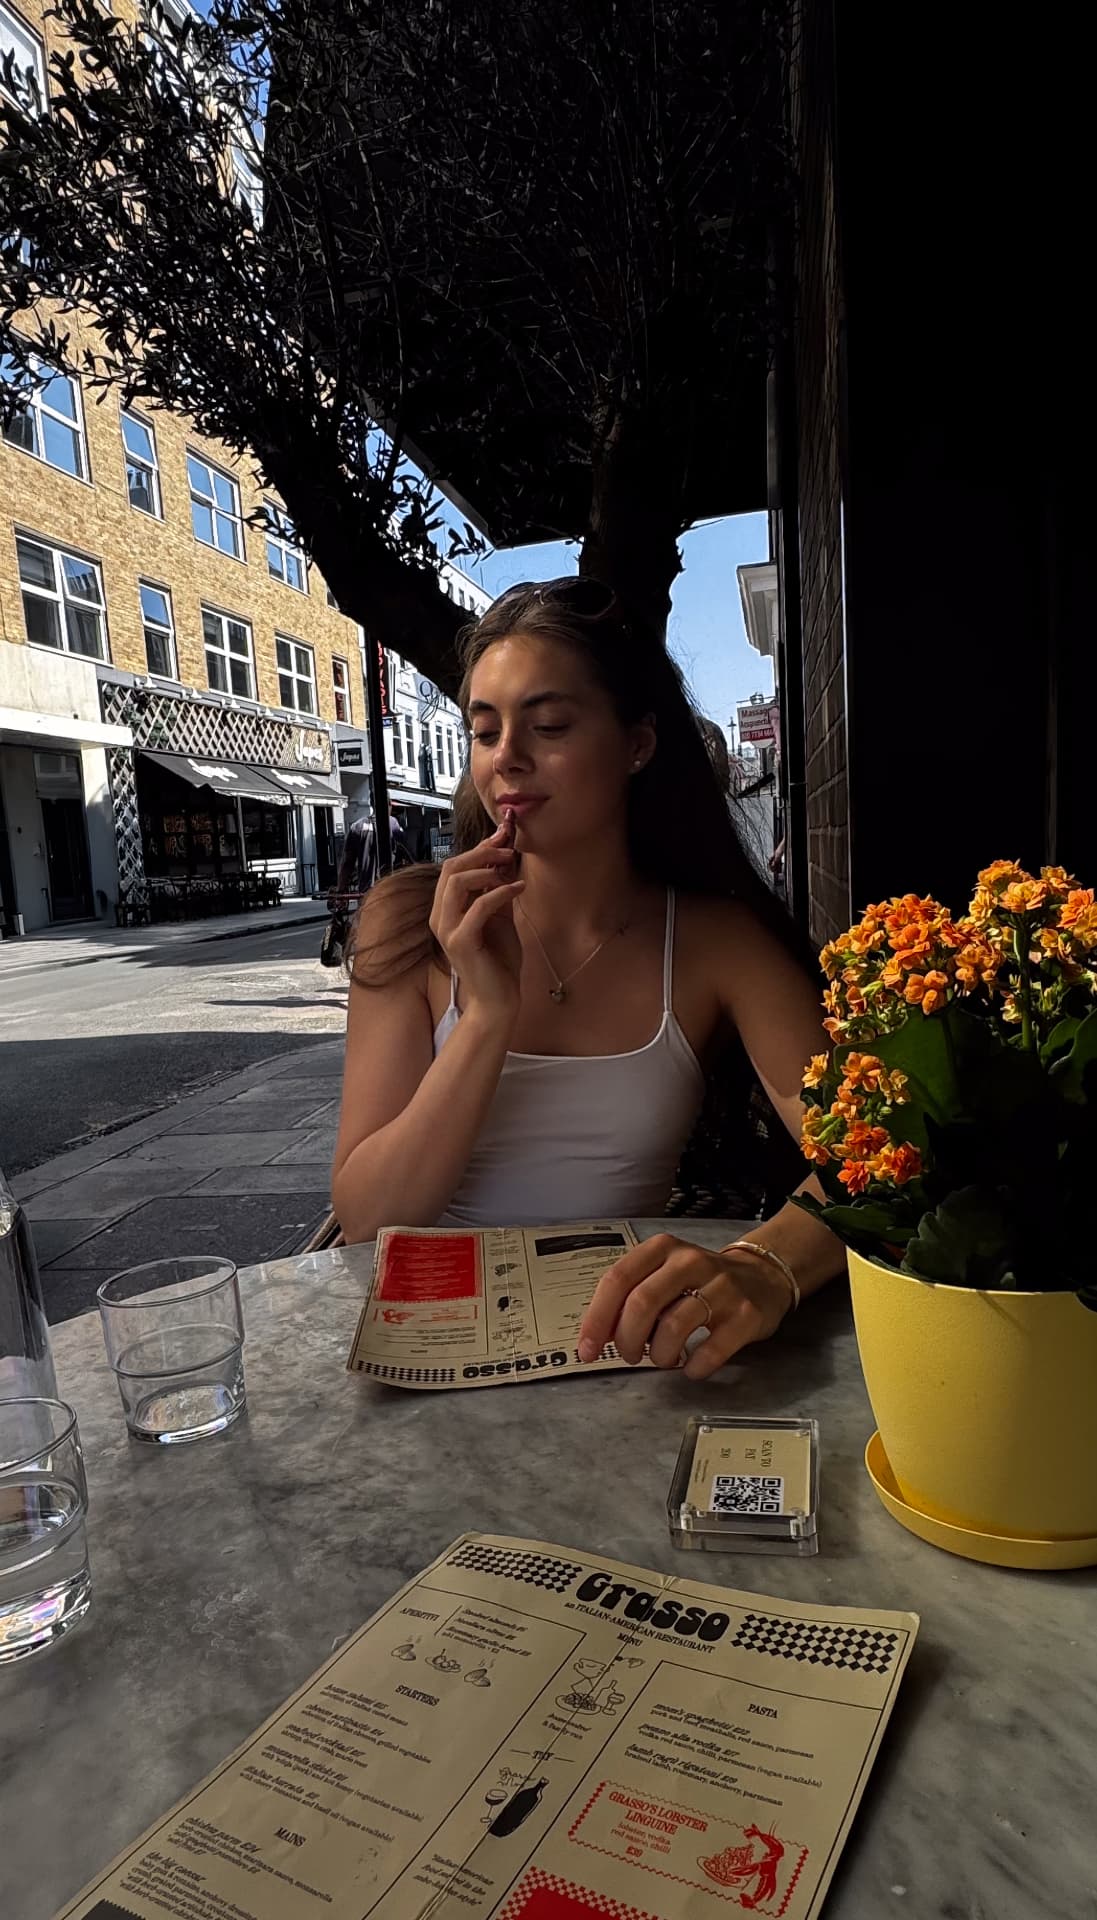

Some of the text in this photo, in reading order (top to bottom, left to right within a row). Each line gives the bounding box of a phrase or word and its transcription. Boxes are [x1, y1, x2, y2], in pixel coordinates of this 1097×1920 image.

[462, 1351, 568, 1379] Grasso
[744, 1448, 757, 1460] PAY
[760, 1440, 773, 1468] SCAN TO
[575, 1572, 730, 1642] Grasso
[575, 1603, 657, 1640] ITALIAN-AMERICAN
[654, 1631, 716, 1654] RESTAURANT
[617, 1632, 644, 1647] MENU
[395, 1685, 441, 1707] STARTERS
[746, 1703, 778, 1719] PASTA
[609, 1791, 709, 1832] GRASSO'S LOBSTER
[625, 1810, 678, 1835] LINGUINE
[274, 1828, 306, 1847] MAINS
